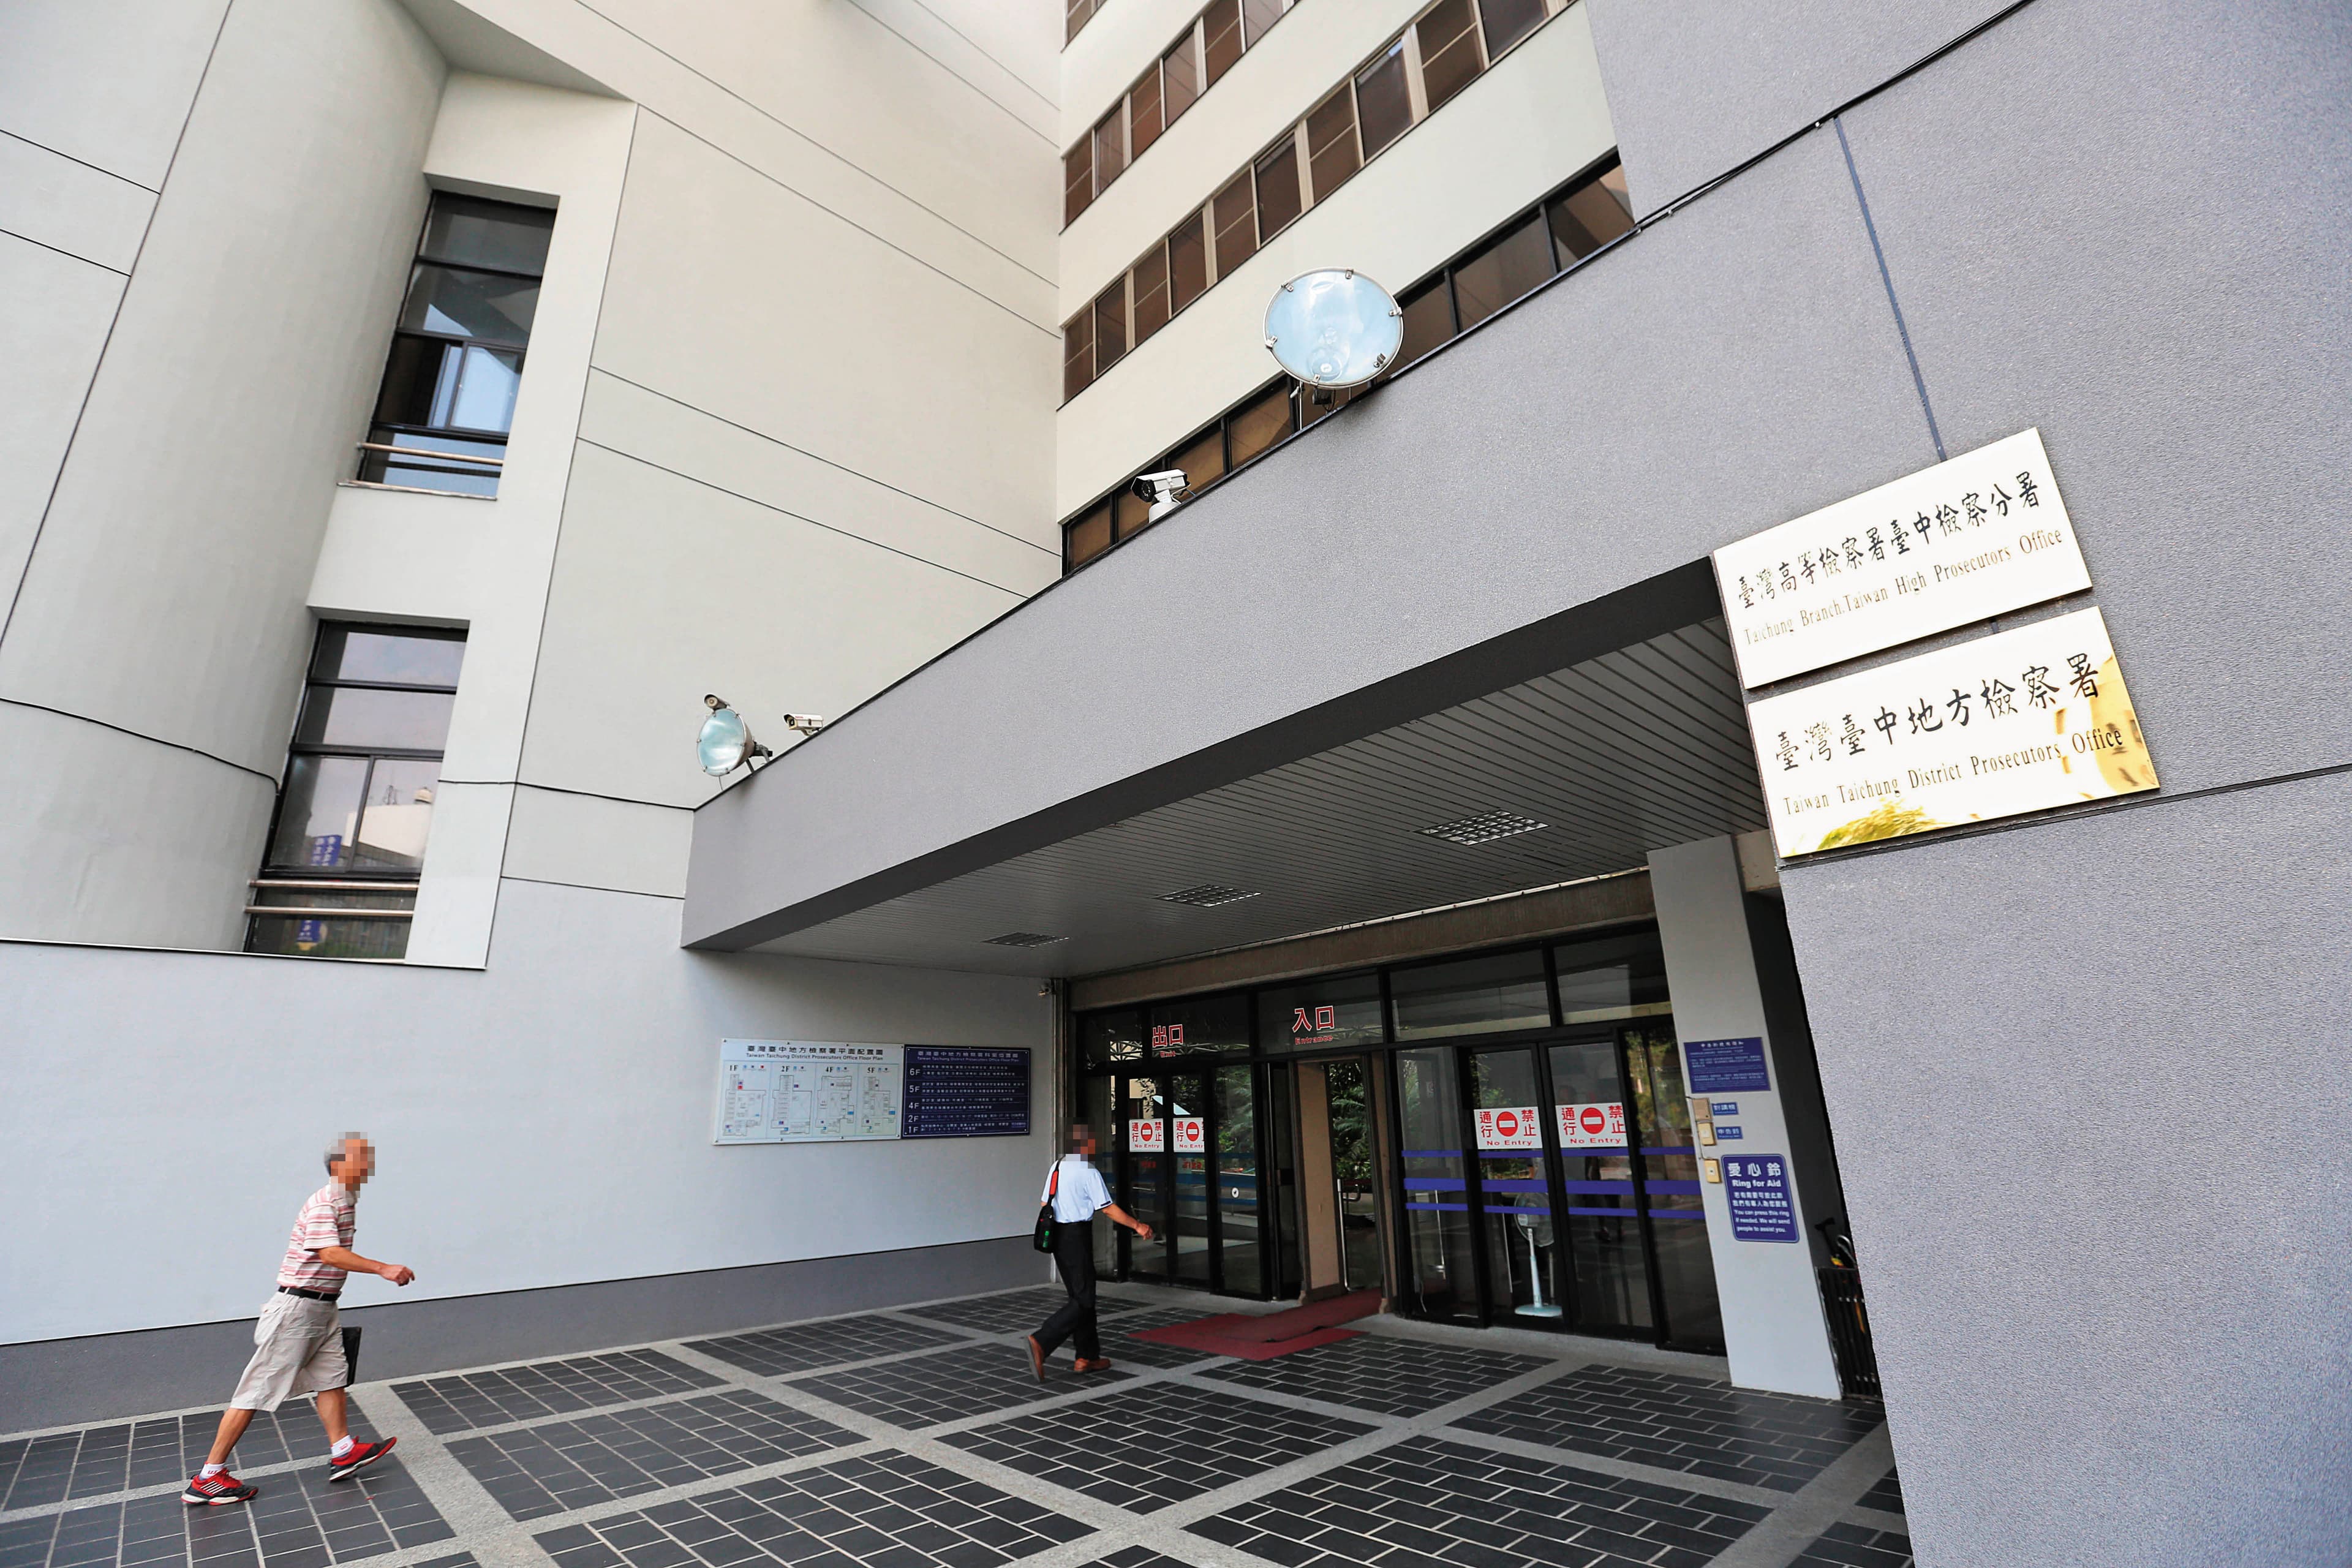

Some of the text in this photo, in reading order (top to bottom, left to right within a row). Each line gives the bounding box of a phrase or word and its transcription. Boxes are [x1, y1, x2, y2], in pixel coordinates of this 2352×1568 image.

[1738, 471, 2040, 608] 臺灣高等檢察署臺中檢察分署
[1744, 620, 1794, 645] Taichung
[1895, 571, 1927, 595] High
[1934, 546, 2012, 582] Prosecutors
[2019, 529, 2063, 554] Office
[1776, 653, 2099, 771] 臺灣臺中地方檢察署
[1783, 728, 2123, 815] Taiwan Taichung District Prosecutors Office
[1292, 1005, 1335, 1033] 入口
[1152, 1023, 1184, 1048] 出口
[1295, 1035, 1333, 1045] Entrance
[908, 1114, 919, 1123] 2F
[1131, 1121, 1139, 1142] 通行
[1155, 1121, 1162, 1142] 禁止
[1176, 1121, 1184, 1142] 通行
[1479, 1111, 1493, 1138] 通行
[1521, 1109, 1536, 1137] 禁止
[1561, 1107, 1577, 1136] 通行
[1608, 1105, 1626, 1134] 禁止
[1728, 1163, 1781, 1177] 愛心鈴
[1732, 1180, 1752, 1188] Ring
